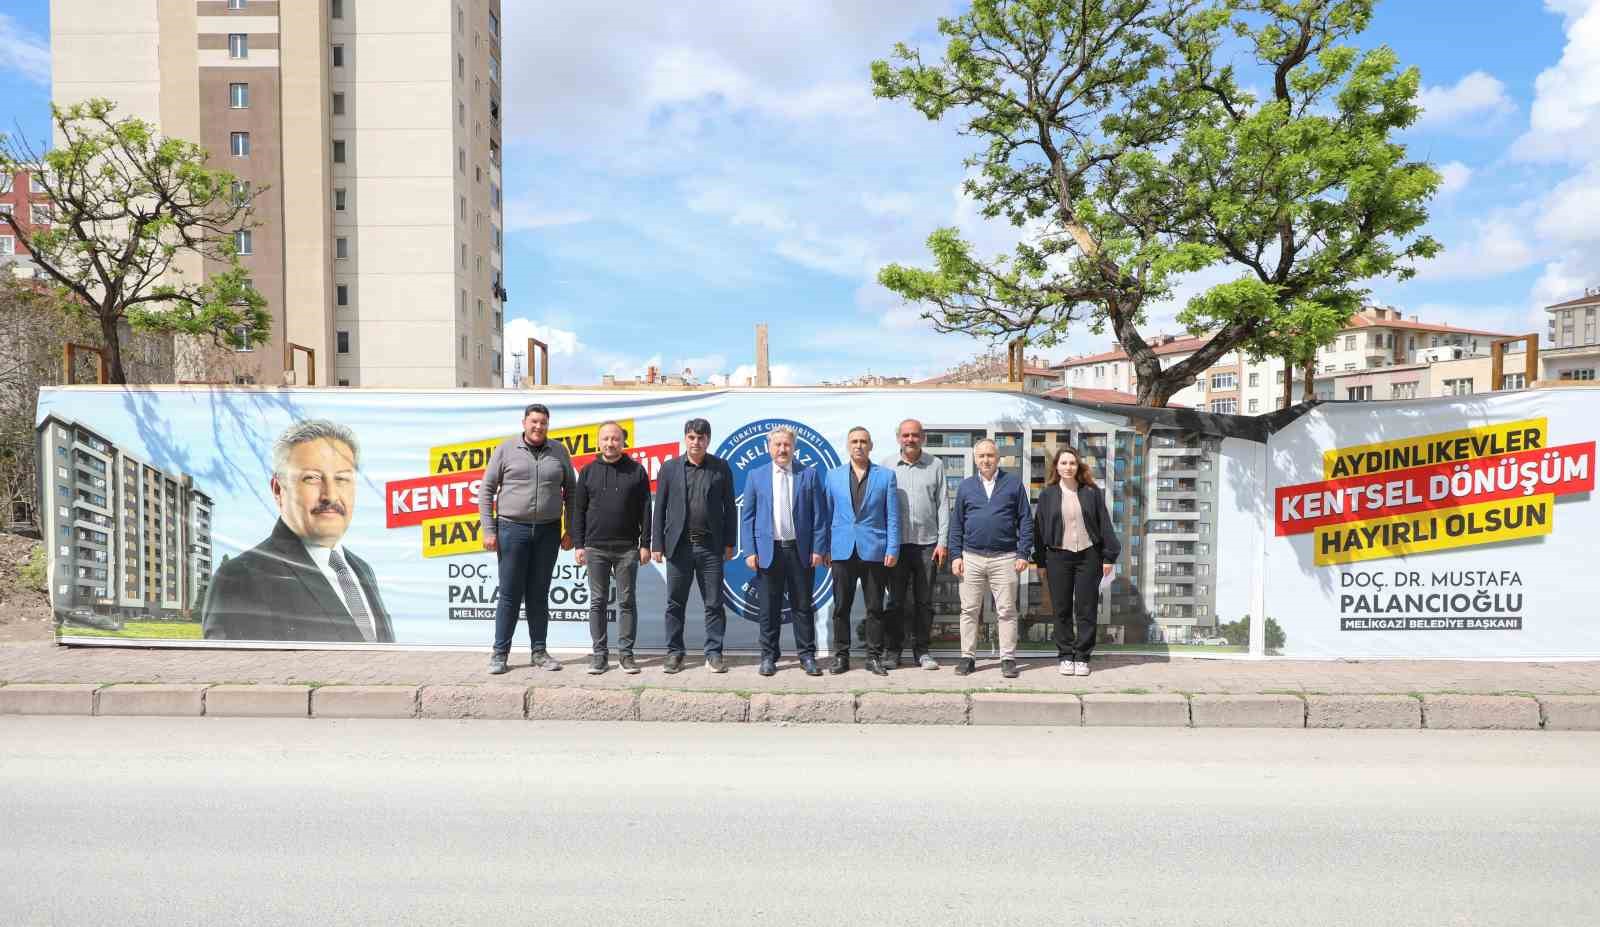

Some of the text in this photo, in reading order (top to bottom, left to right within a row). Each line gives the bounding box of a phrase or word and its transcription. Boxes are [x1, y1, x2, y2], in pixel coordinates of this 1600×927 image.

[1331, 428, 1541, 478] AYDINLIKEVLER
[1281, 451, 1588, 522] KENTSEL DÖNÜŞÜM
[1321, 503, 1546, 554] HAYIRLI OLSUN
[449, 563, 492, 583] DOÇ.
[1341, 571, 1523, 591] DOÇ. DR. MUSTAFA
[1340, 589, 1523, 614] PALANCIOĞLU
[1345, 618, 1518, 630] MELİKGAZİ BELEDİYE BAŞKANI
